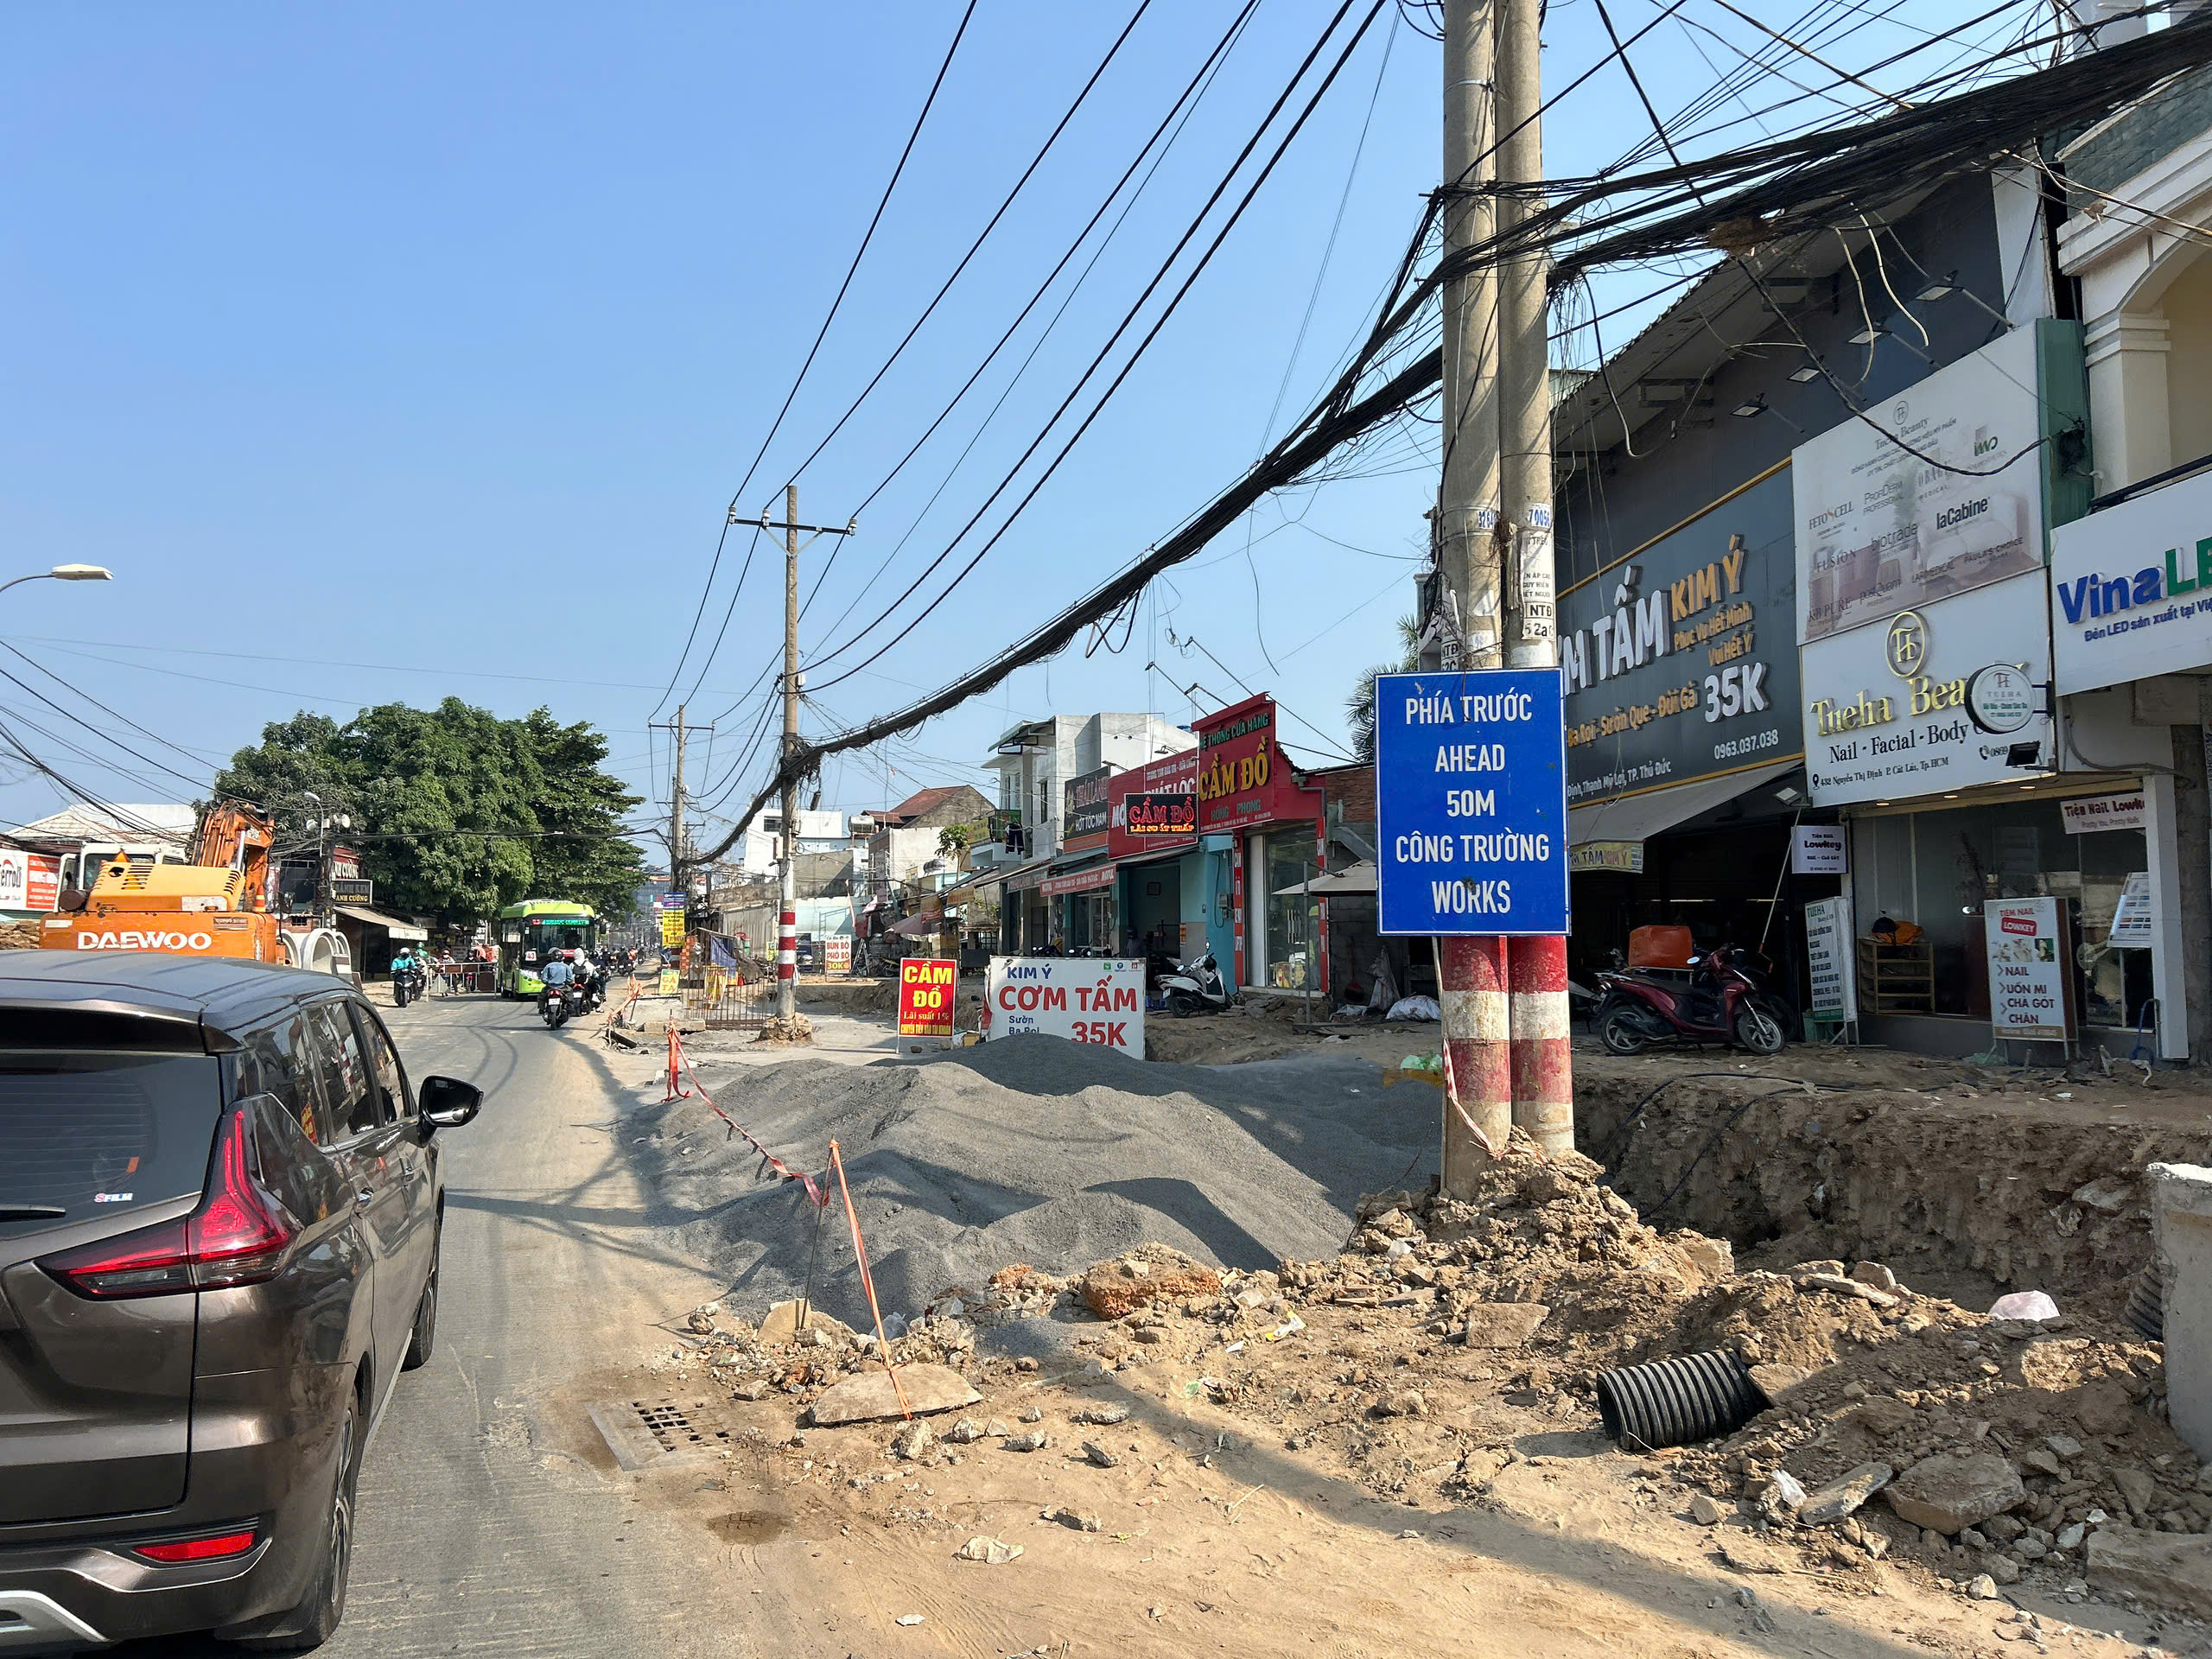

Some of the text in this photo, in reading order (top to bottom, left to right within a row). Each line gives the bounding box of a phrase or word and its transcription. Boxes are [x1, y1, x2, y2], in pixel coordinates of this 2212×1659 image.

[1936, 498, 1989, 531] laCabine
[1530, 604, 1552, 616] NTĐ
[1593, 565, 1667, 681] TẤM
[1671, 563, 1720, 622] KIM
[1723, 534, 1745, 594] Ý
[2107, 620, 2129, 636] LED
[2131, 615, 2151, 630] sản
[2153, 605, 2178, 625] xuất
[1704, 662, 1765, 723] 35K
[1405, 687, 1533, 725] PHÍA TRƯỚC
[1809, 690, 1892, 736] Tueha
[1208, 725, 1230, 747] THỐNG
[1248, 712, 1269, 731] HÀNG
[1829, 741, 1858, 764] Nail
[1872, 730, 1916, 757] Facial
[1927, 720, 1970, 744] Body
[1713, 729, 1779, 760] 0963.037.038
[1199, 753, 1236, 801] CẦM
[1241, 735, 1268, 791] ĐỒ
[1434, 745, 1505, 772] AHEAD
[1628, 769, 1639, 783] TP.
[1640, 761, 1653, 779] Thủ
[1656, 758, 1672, 776] Đức
[1129, 797, 1166, 823] CẦM
[1171, 797, 1194, 823] ĐỒ
[1446, 790, 1496, 817] 50M
[2088, 800, 2109, 815] Nail
[1395, 827, 1550, 863] CÔNG TRƯỜNG
[1804, 841, 1841, 851] Lowkey
[348, 893, 368, 902] CƯỜNG
[1432, 880, 1511, 914] WORKS
[2003, 921, 2035, 933] LOWKEY
[78, 931, 213, 950] DAEWOO
[904, 961, 953, 984] CẦM
[1007, 963, 1052, 979] KIM Ý
[2005, 966, 2029, 976] NAIL
[912, 985, 942, 1008] ĐỒ
[999, 975, 1137, 1012] CƠM TẤM
[2034, 984, 2047, 994] MI
[903, 1011, 916, 1020] Lãi
[918, 1010, 934, 1020] suất
[1008, 1014, 1034, 1024] Sườn
[2009, 1012, 2039, 1024] CHÂN
[1071, 1022, 1128, 1046] 35K
